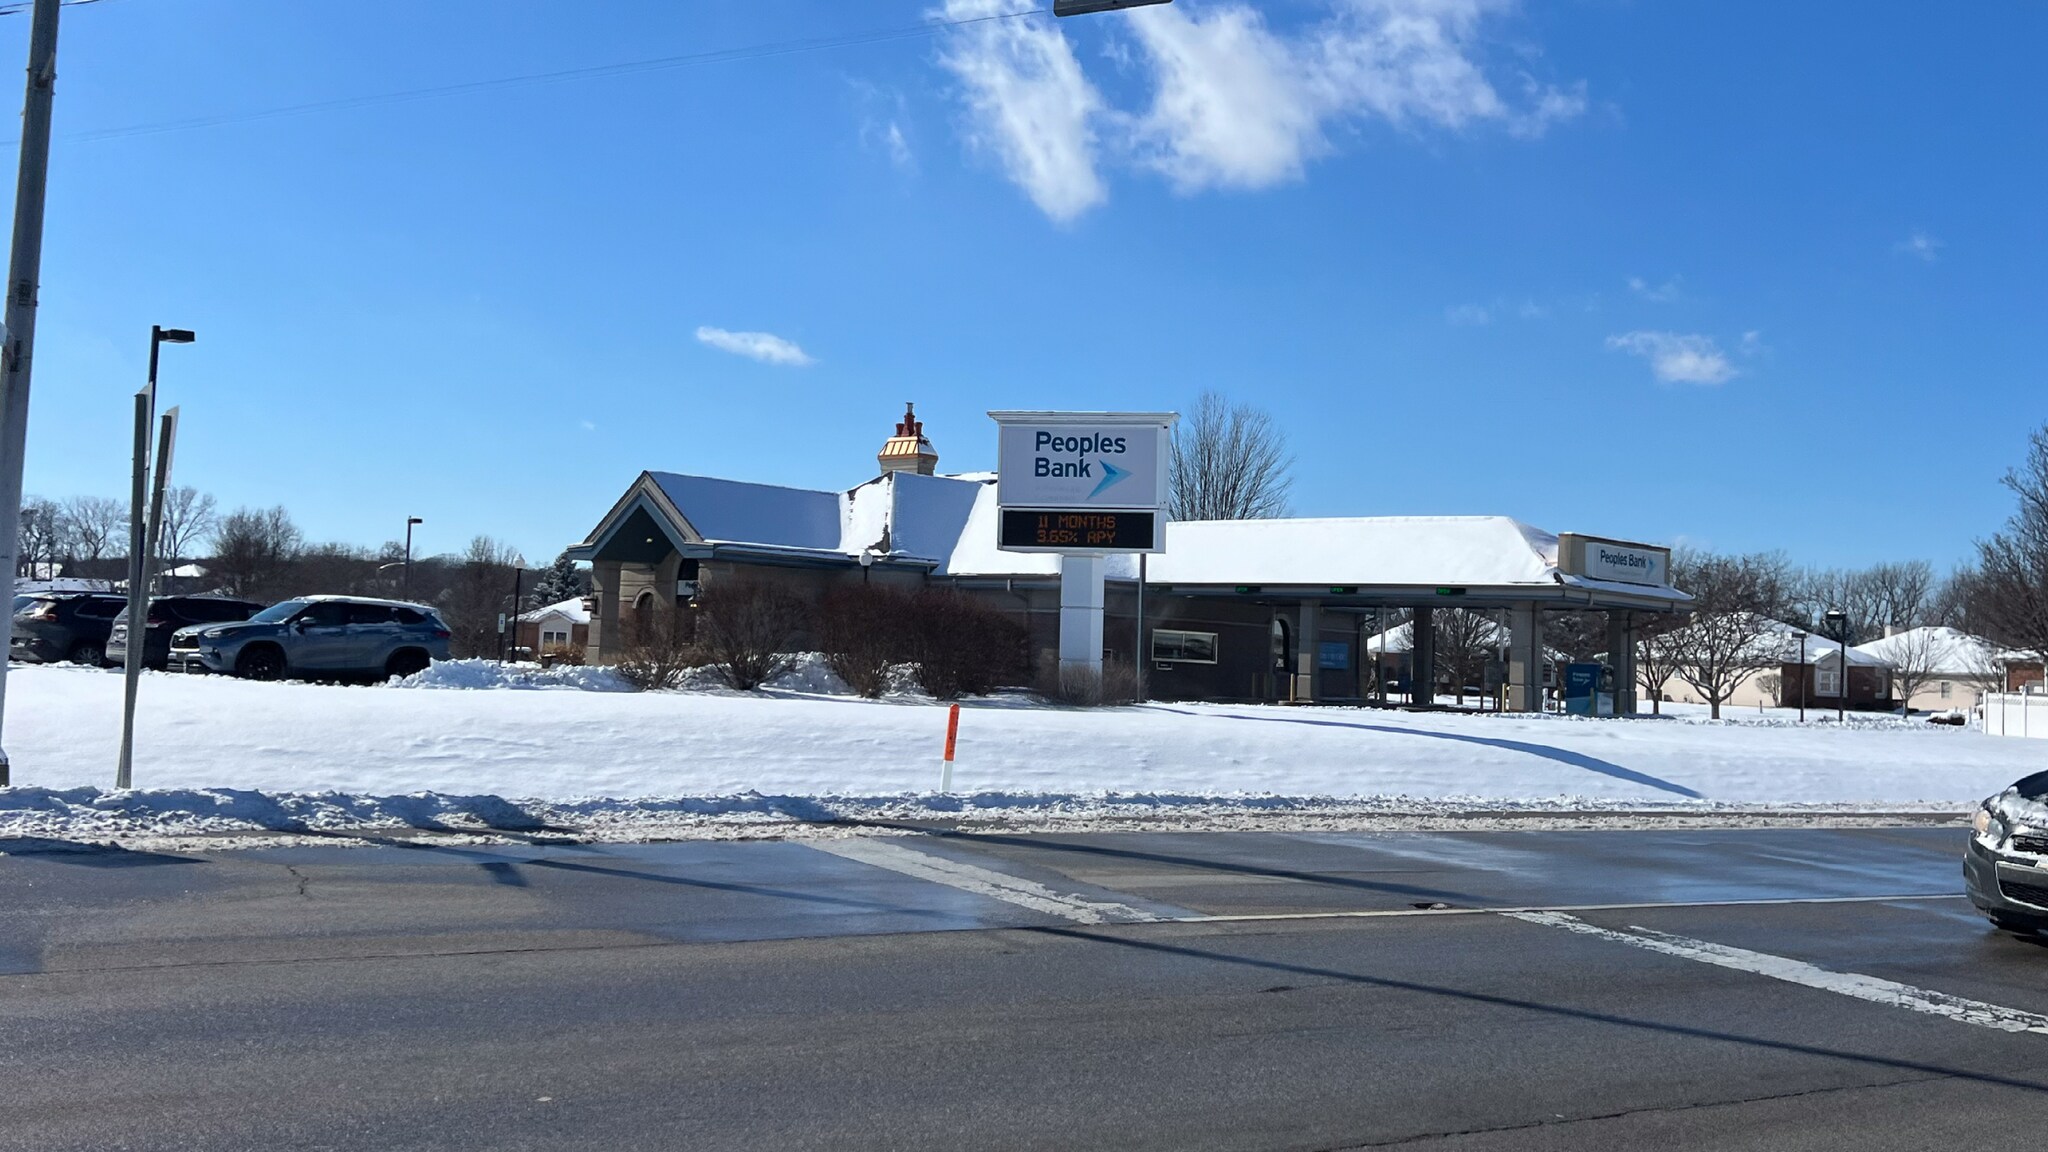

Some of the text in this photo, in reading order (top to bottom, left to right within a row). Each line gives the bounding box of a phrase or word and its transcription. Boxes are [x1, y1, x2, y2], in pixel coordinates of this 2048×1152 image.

[1035, 431, 1126, 457] Peoples
[1034, 457, 1091, 477] Bank
[1038, 515, 1116, 529] 11 MONTHS
[1087, 531, 1116, 544] APY
[1600, 549, 1647, 568] Peoples Bank
